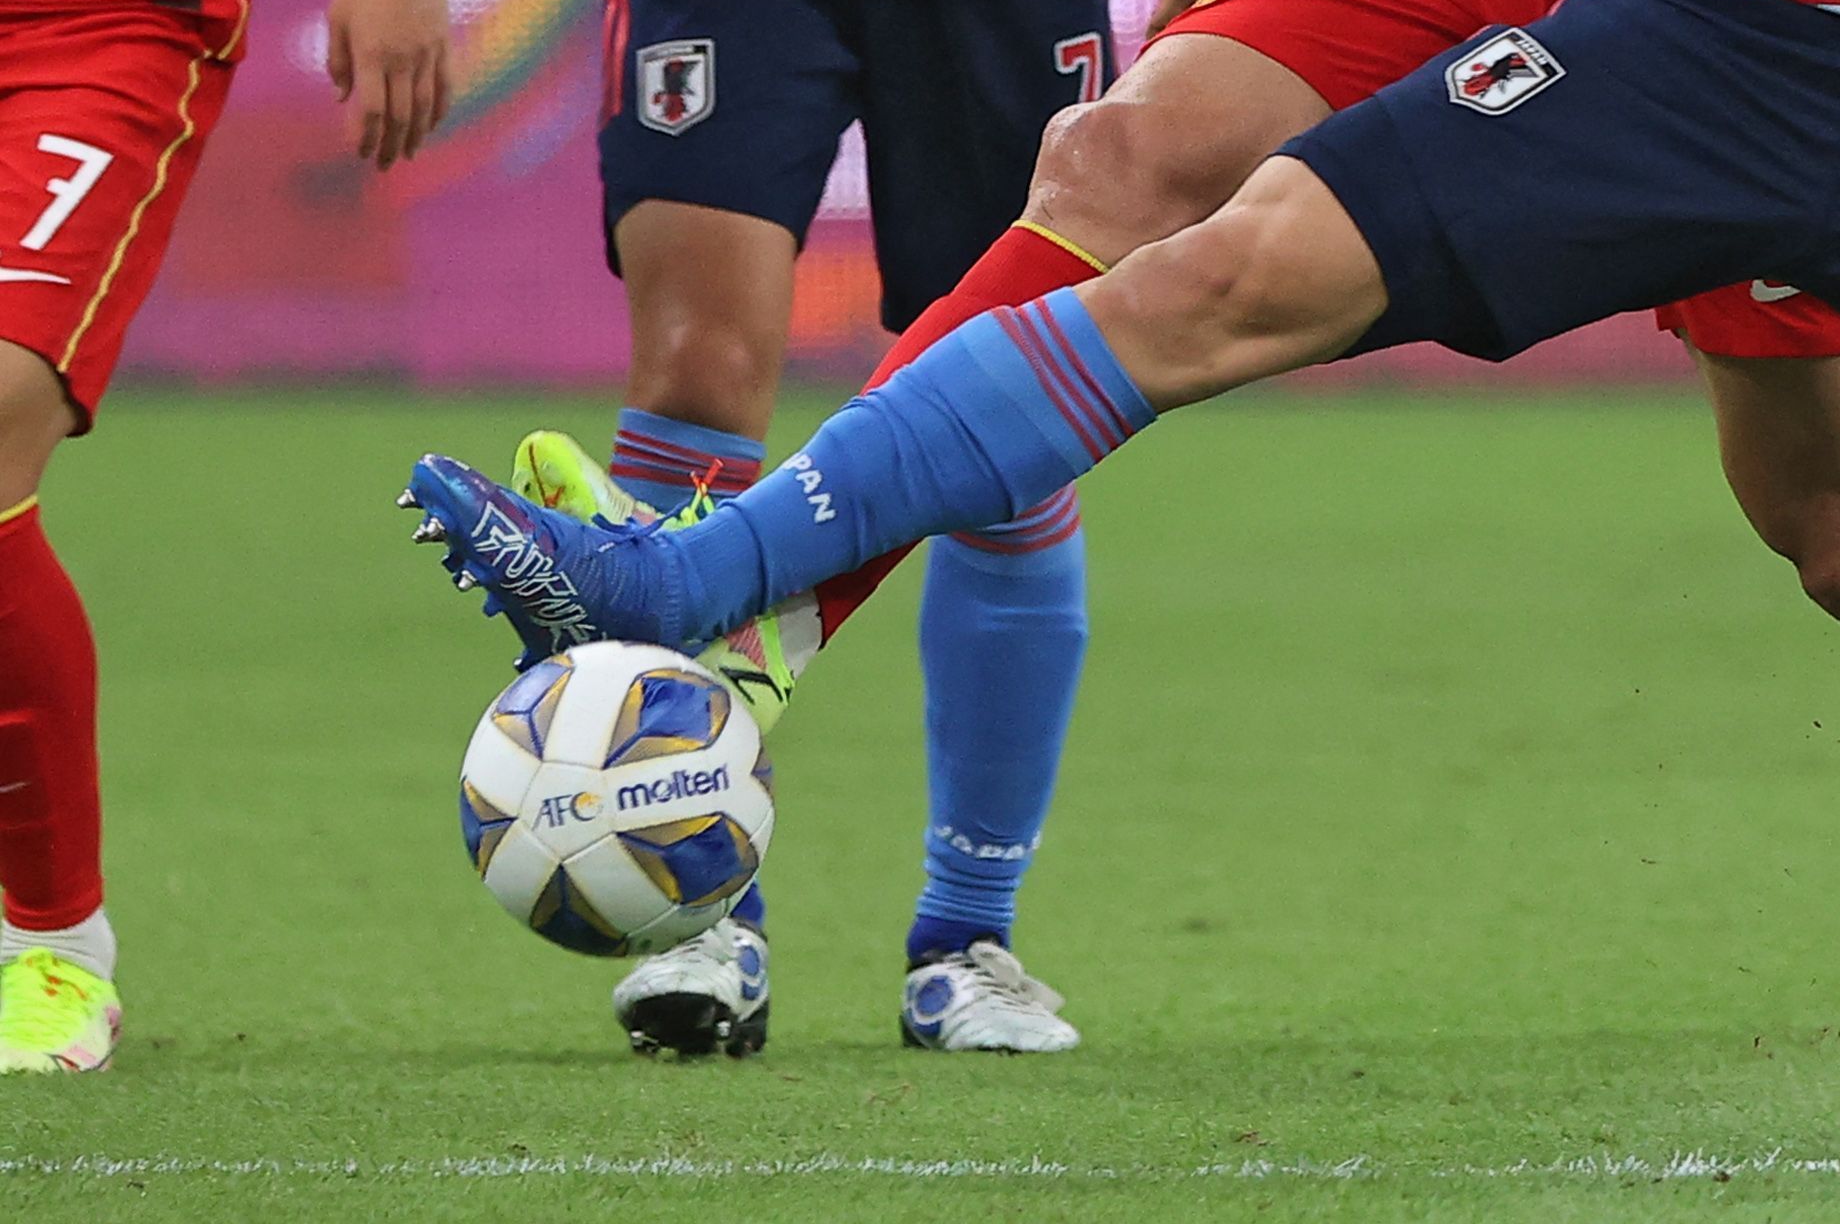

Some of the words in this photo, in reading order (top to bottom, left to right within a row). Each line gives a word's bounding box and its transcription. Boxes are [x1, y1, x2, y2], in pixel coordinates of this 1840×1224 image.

[20, 134, 115, 251] 7
[532, 790, 603, 831] AFC
[617, 763, 730, 811] molten
